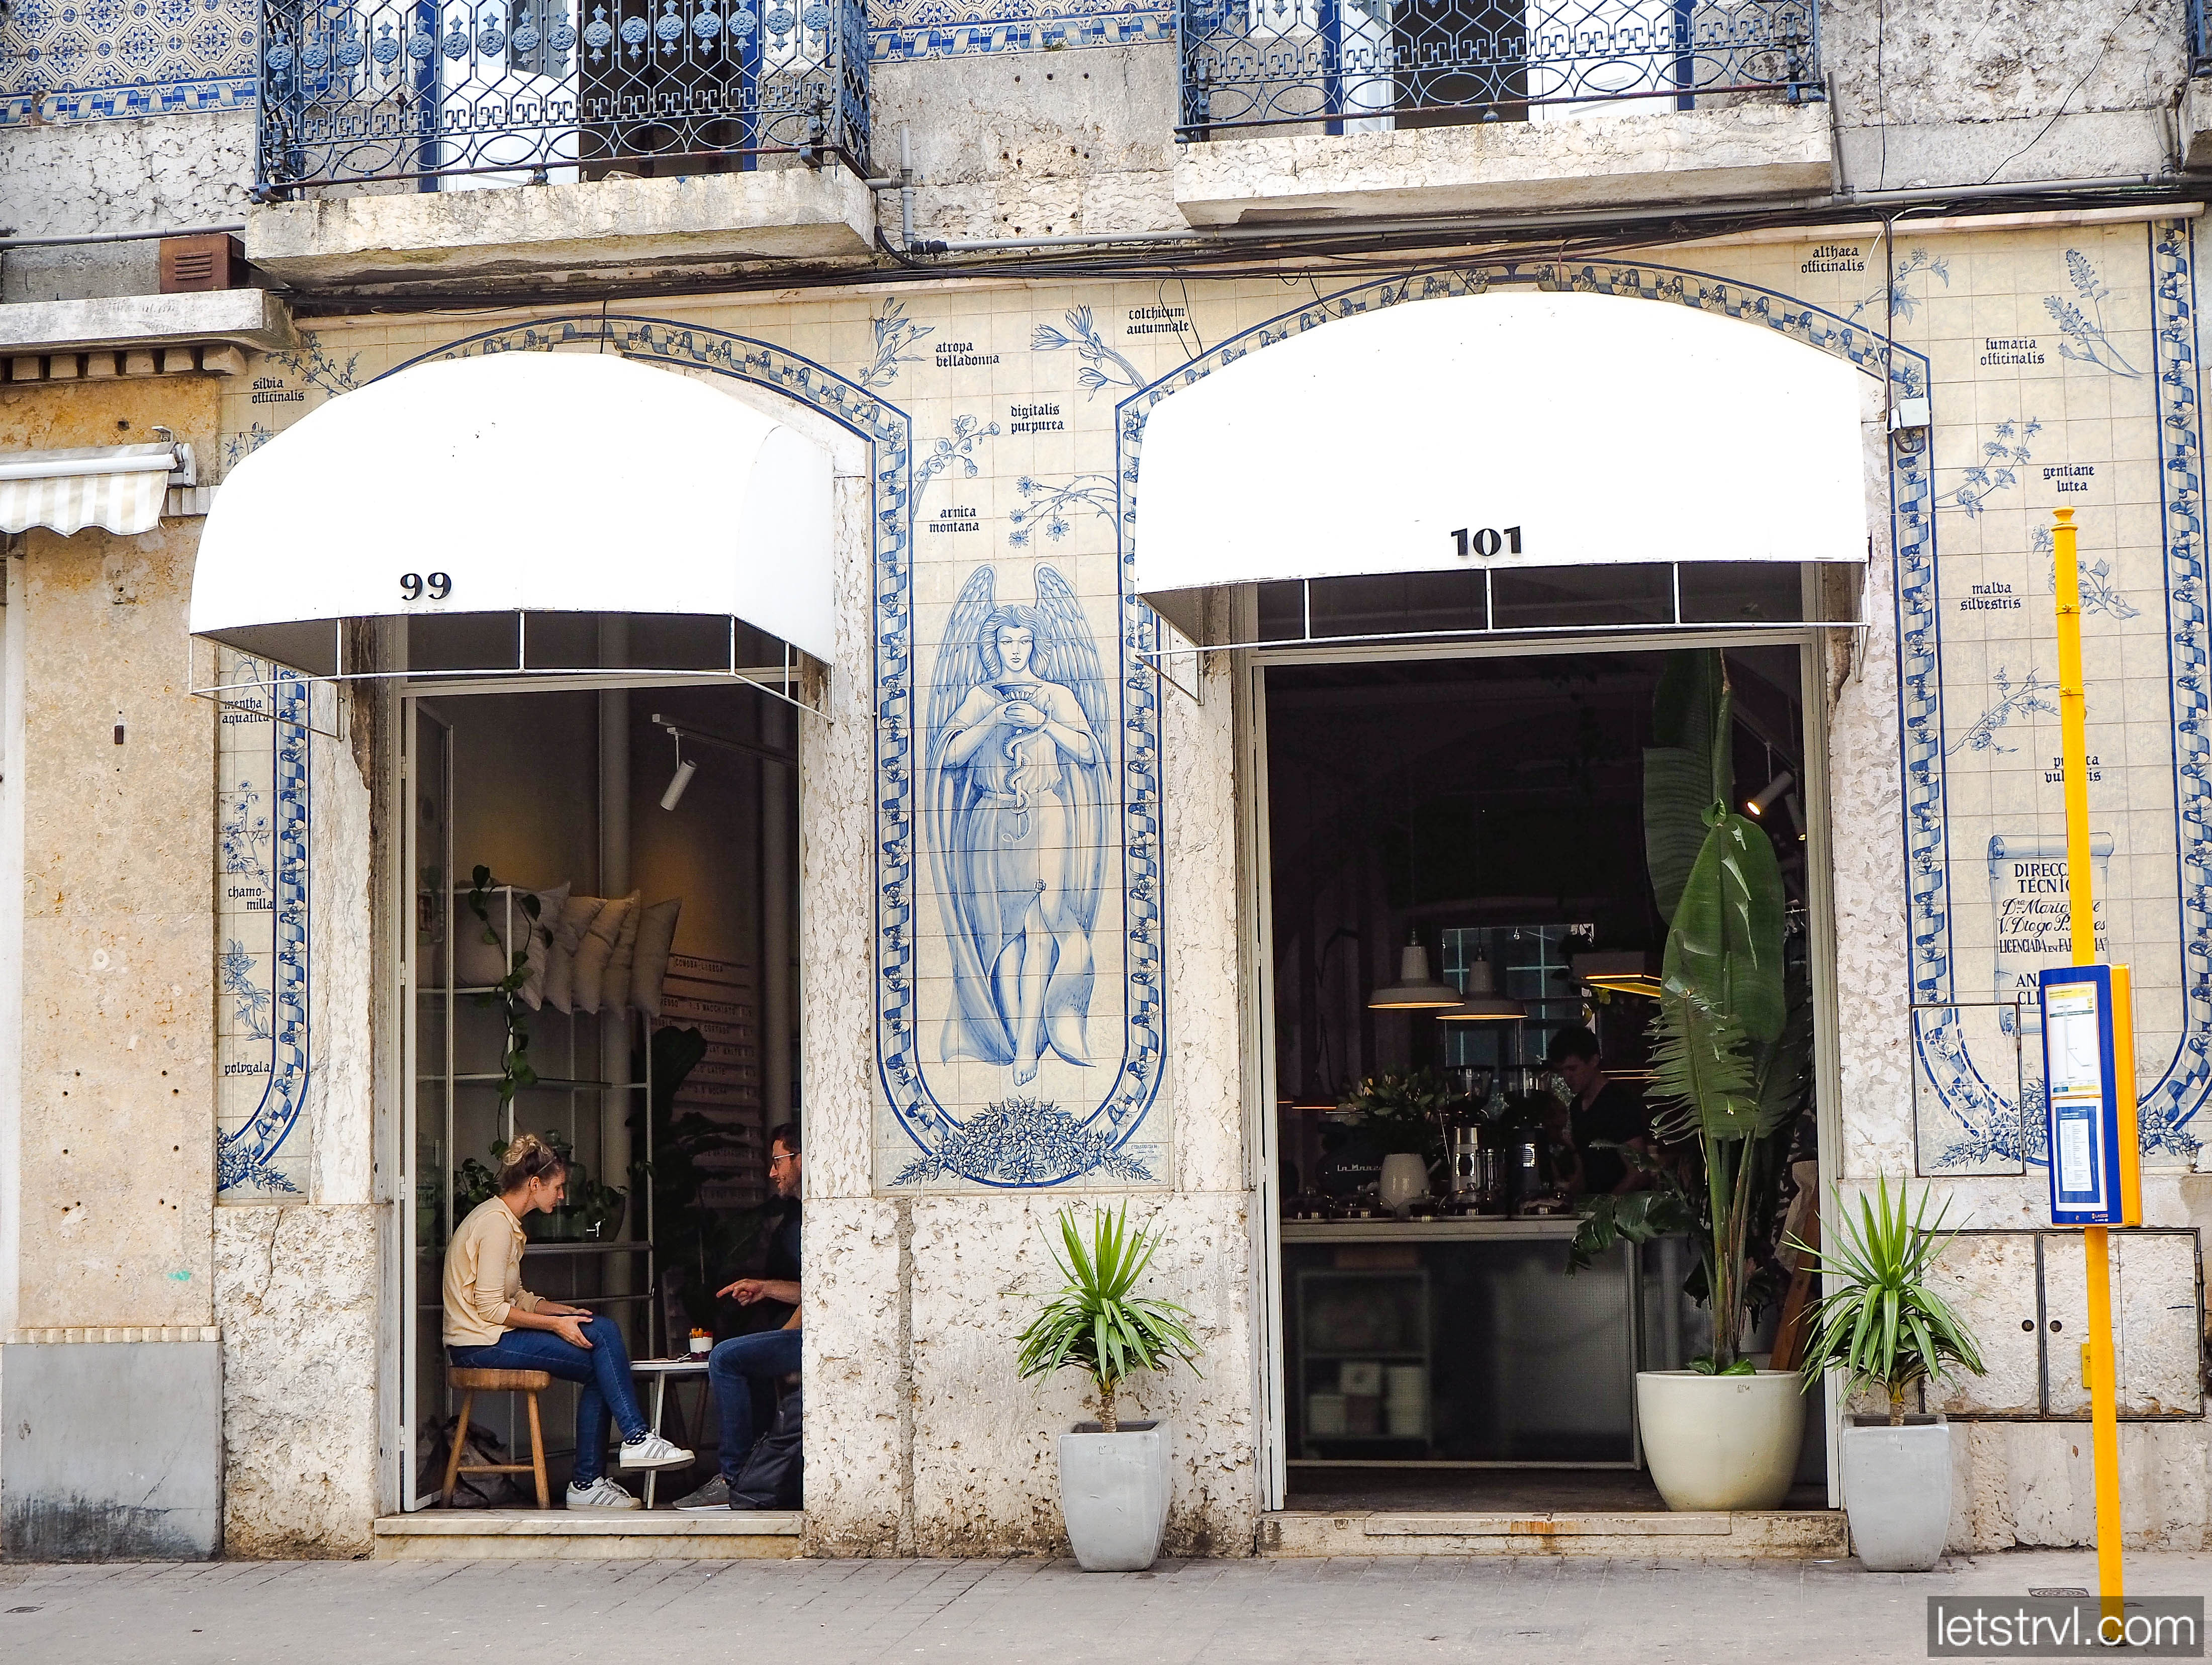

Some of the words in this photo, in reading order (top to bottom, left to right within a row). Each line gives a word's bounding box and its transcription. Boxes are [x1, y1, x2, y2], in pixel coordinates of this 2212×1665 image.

[1812, 245, 1860, 260] althaea
[1801, 259, 1865, 273] officinalis
[1128, 306, 1185, 320] colchicum
[1127, 320, 1189, 334] autumnale
[936, 341, 974, 355] atropa
[1986, 337, 2037, 350] fumaria
[936, 354, 999, 367] belladonna
[1980, 351, 2045, 366] officinalis
[252, 377, 284, 390] silvia
[252, 390, 304, 404] officinalis
[1010, 404, 1059, 419] digitalis
[1011, 420, 1064, 435] purpurea
[2043, 465, 2095, 480] gentiane
[2057, 480, 2088, 493] lutea
[940, 507, 976, 519] arnica
[929, 521, 979, 533] montana
[1451, 525, 1521, 557] 101
[400, 572, 452, 601] 99
[1972, 582, 2012, 595] malva
[1960, 597, 2021, 611] silvestris
[225, 697, 262, 711] mentha
[2045, 769, 2101, 783] vulis
[2014, 863, 2069, 879] DIRECÇ
[2017, 877, 2070, 893] TÉCNI
[228, 886, 266, 900] chamo-
[246, 898, 273, 910] milla
[2023, 898, 2068, 915] Maria
[2011, 915, 2053, 938] Diogo
[1999, 939, 2048, 953] LICENCIADA
[2058, 938, 2105, 952] FAIA
[225, 1061, 270, 1077] polygala
